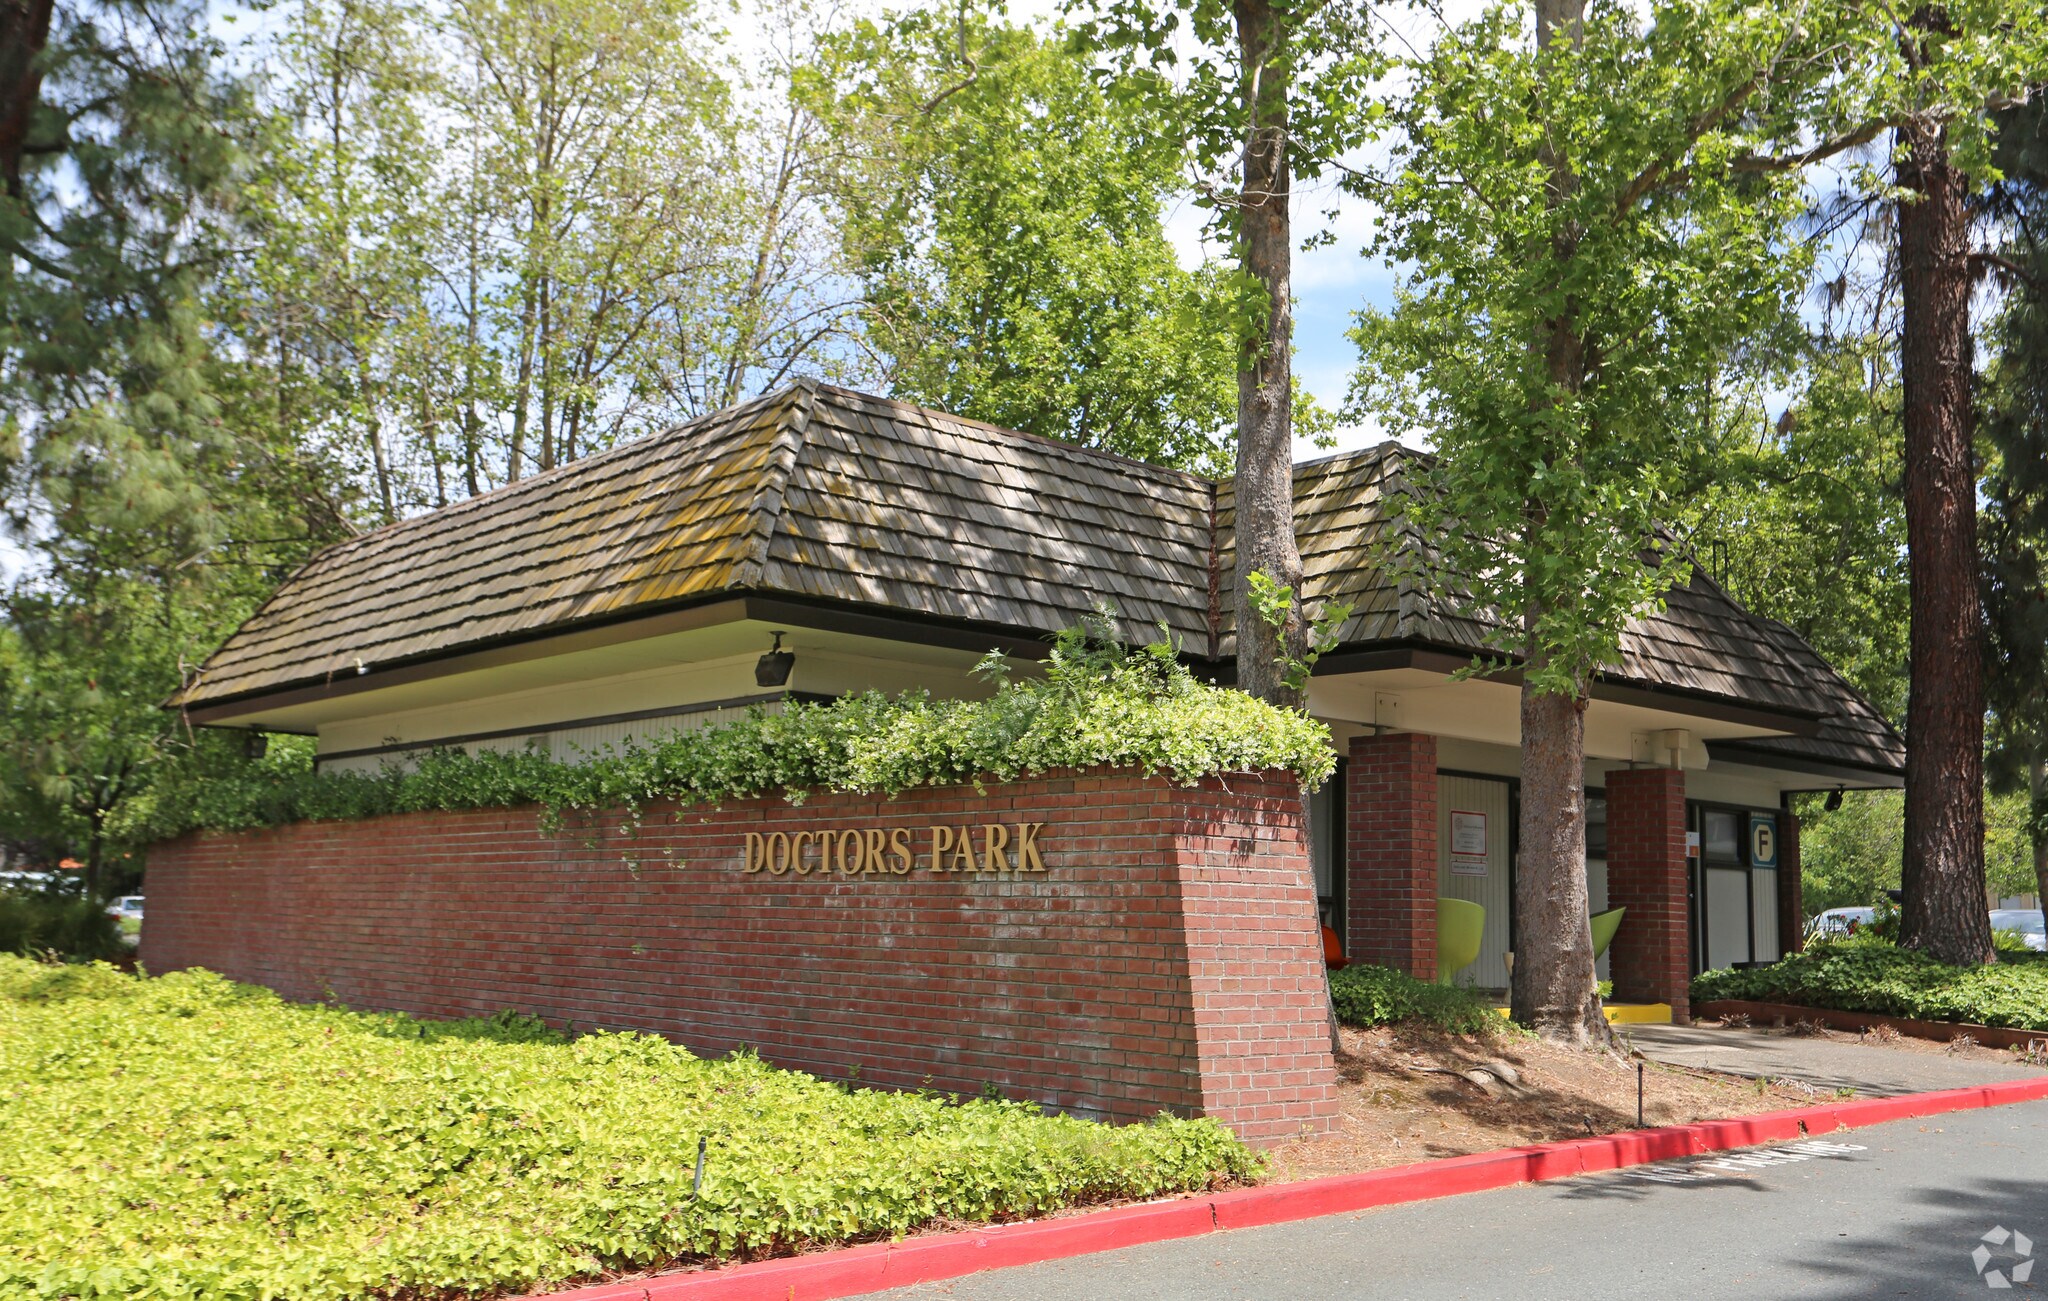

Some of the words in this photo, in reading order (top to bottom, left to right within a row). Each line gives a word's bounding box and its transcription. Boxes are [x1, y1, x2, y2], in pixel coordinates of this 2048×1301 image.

[744, 828, 912, 875] DOCTORS
[929, 823, 1048, 872] PARK
[1758, 829, 1769, 857] F
[1690, 1140, 1868, 1172] PARKING
